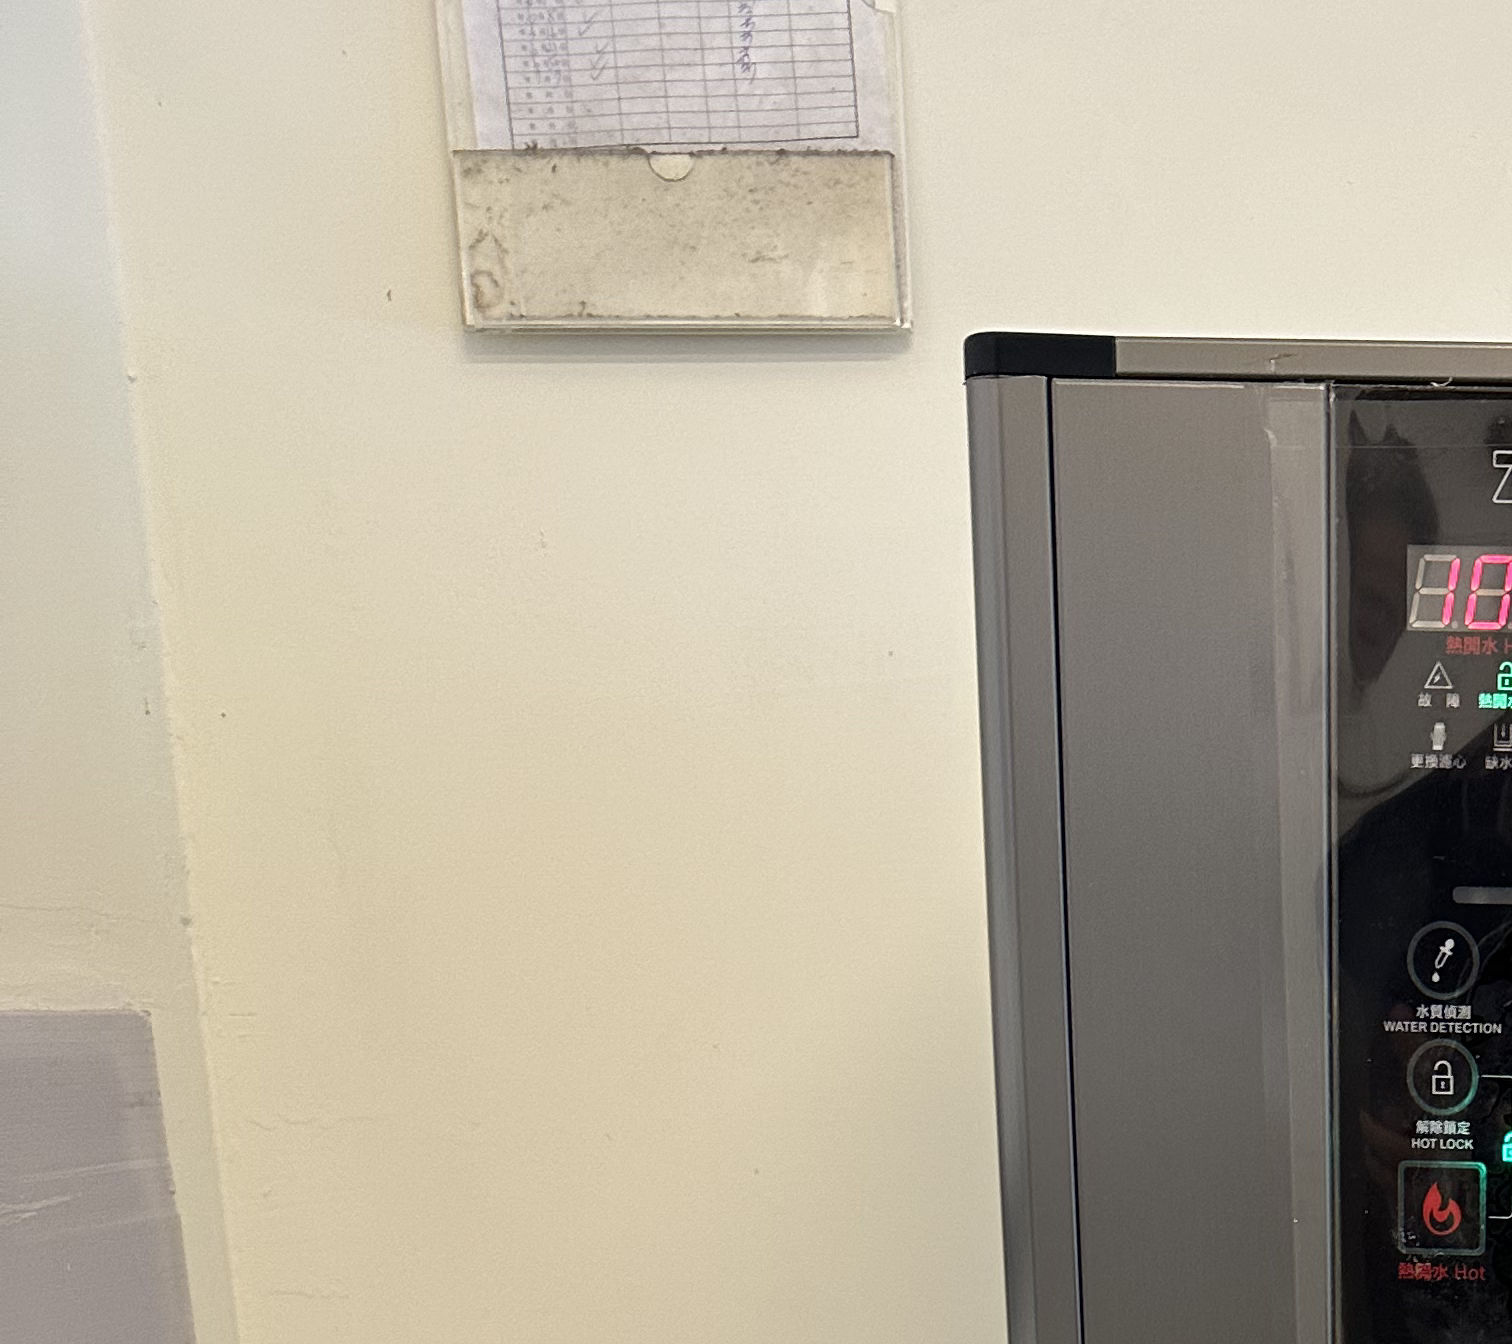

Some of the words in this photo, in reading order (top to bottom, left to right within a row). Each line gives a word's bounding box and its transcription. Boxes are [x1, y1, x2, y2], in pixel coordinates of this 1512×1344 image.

[1384, 1021, 1428, 1033] WATER
[1430, 1022, 1502, 1034] DETECTION
[1412, 1138, 1438, 1149] HOT
[1439, 1138, 1474, 1150] LOCK
[1455, 1264, 1486, 1281] Hot
